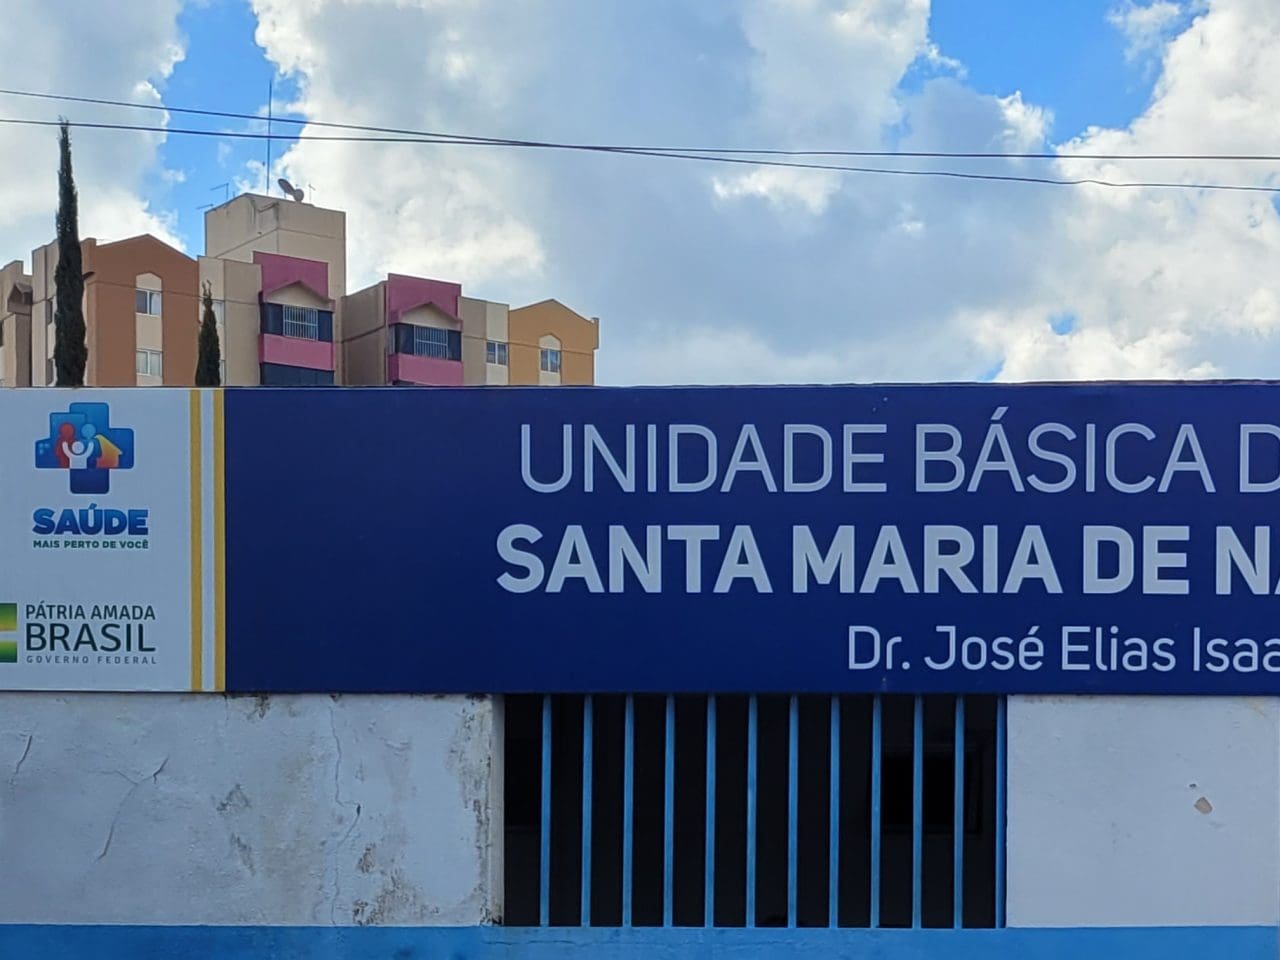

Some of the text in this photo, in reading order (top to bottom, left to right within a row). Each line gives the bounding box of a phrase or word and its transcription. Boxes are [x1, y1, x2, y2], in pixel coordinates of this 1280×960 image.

[520, 423, 888, 494] UNIDADE
[914, 406, 1216, 494] BÁSICA
[32, 503, 149, 535] SAÚDE
[33, 539, 149, 549] MAIS PERTO DE VOCÊ
[496, 523, 773, 594] SANTA
[792, 524, 1063, 594] MARIA
[1083, 525, 1190, 595] DE
[26, 601, 156, 621] PÁTRIA AMADA
[26, 623, 156, 652] BRASIL
[848, 625, 911, 671] Dr.
[924, 625, 1045, 671] José
[1061, 626, 1176, 672] Elias
[27, 655, 157, 665] GOVERNO FEDERAL
